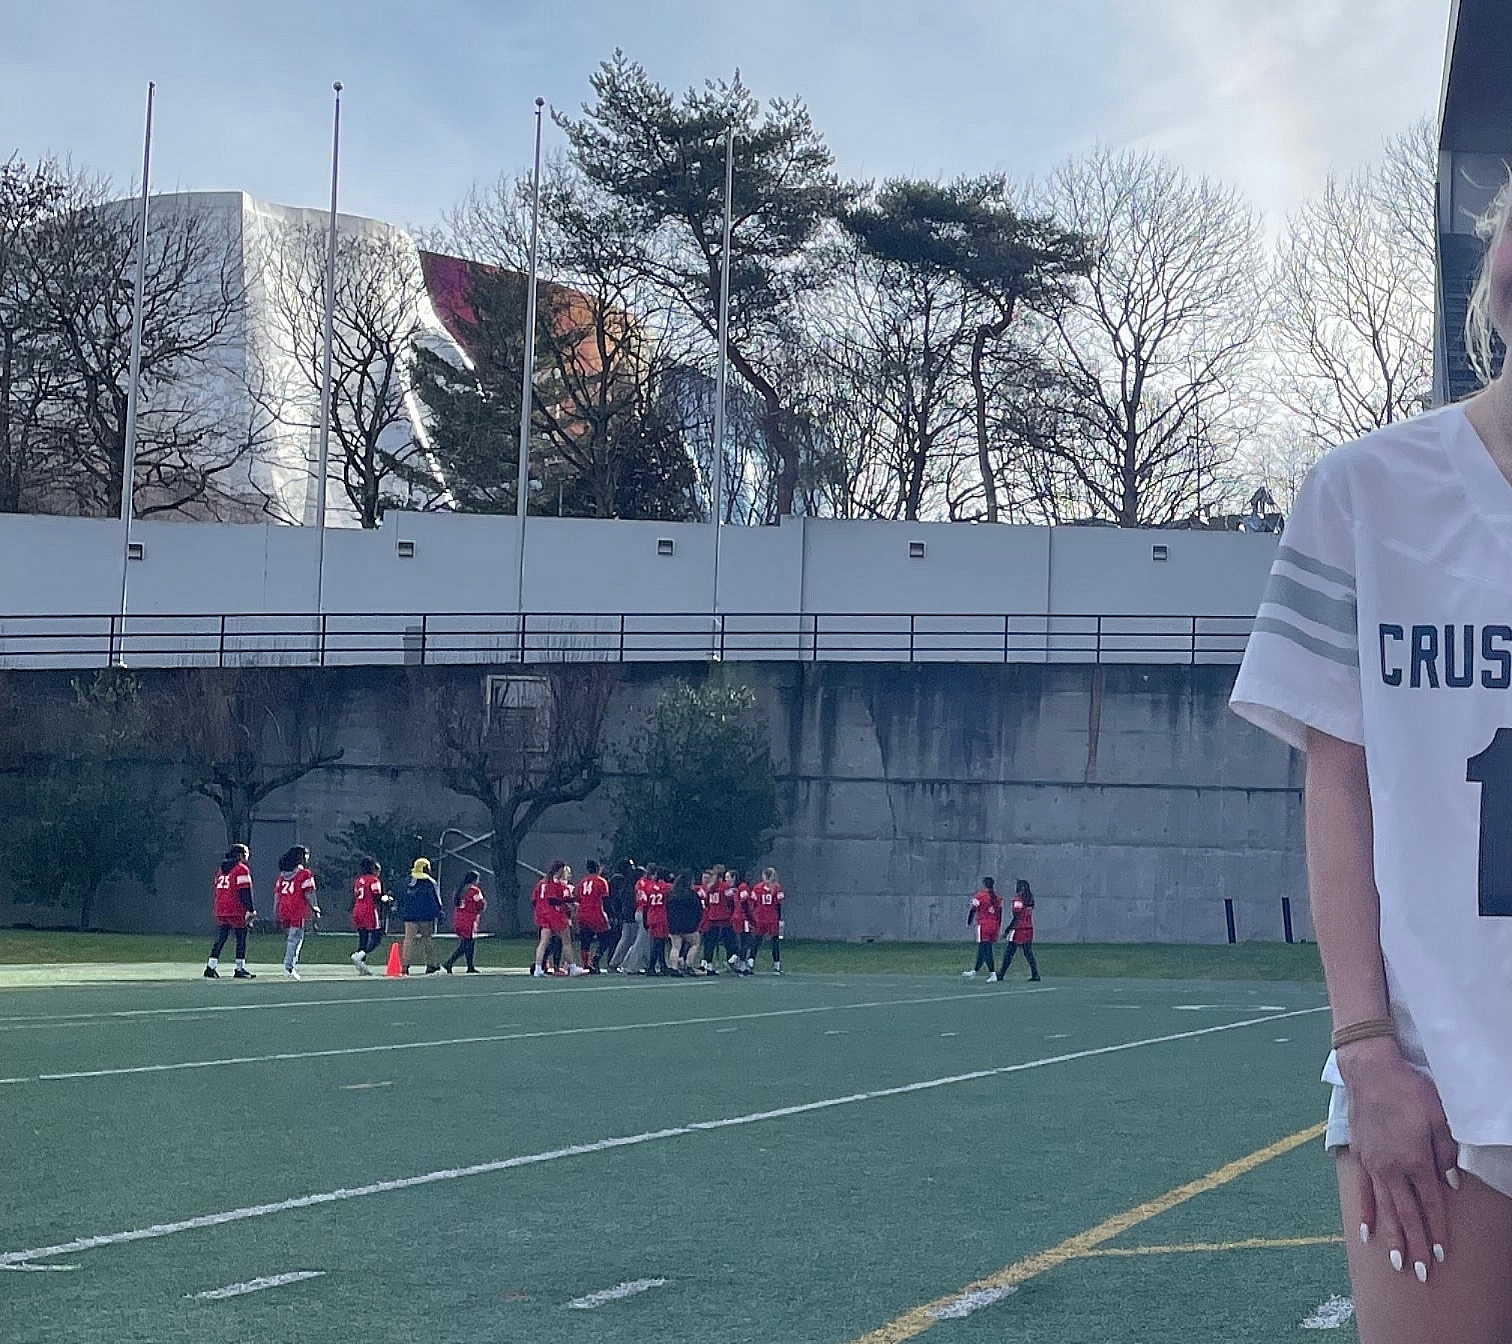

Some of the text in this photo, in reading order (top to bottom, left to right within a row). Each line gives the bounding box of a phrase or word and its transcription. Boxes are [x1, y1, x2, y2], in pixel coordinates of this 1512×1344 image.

[217, 875, 231, 889] 25
[281, 881, 295, 894] 24
[582, 880, 594, 896] 14
[650, 894, 663, 905] 22
[761, 893, 772, 905] 19
